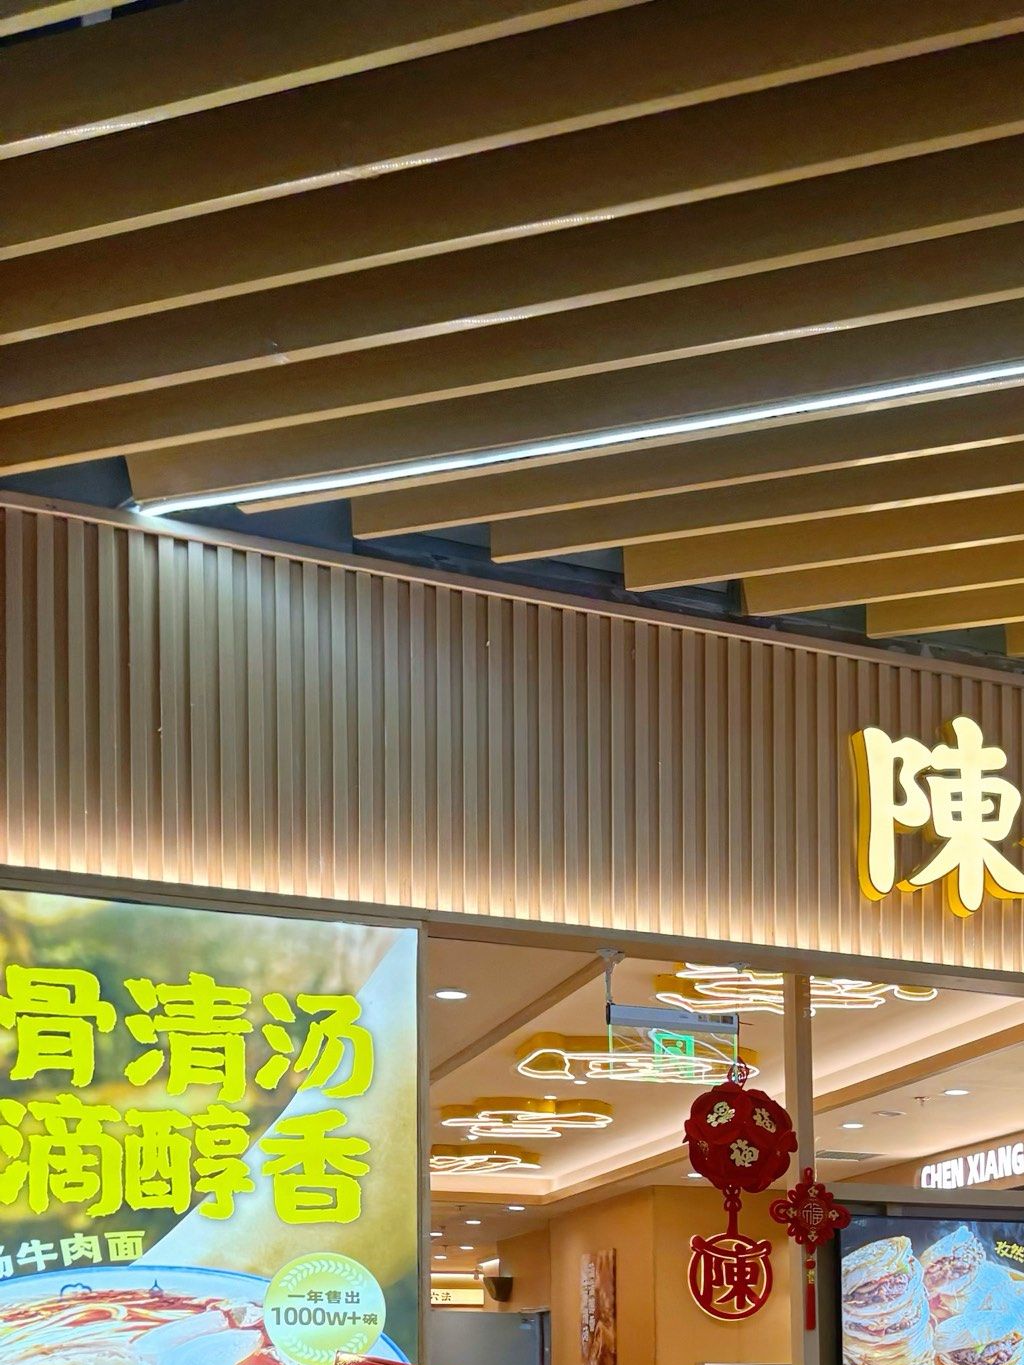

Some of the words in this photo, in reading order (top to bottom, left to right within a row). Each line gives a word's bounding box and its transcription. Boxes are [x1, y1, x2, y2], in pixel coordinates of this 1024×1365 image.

[0, 965, 374, 1103] 骨清汤
[921, 1160, 965, 1190] CHEN
[967, 1142, 1024, 1186] XIANG
[288, 1290, 360, 1303] 一年售出
